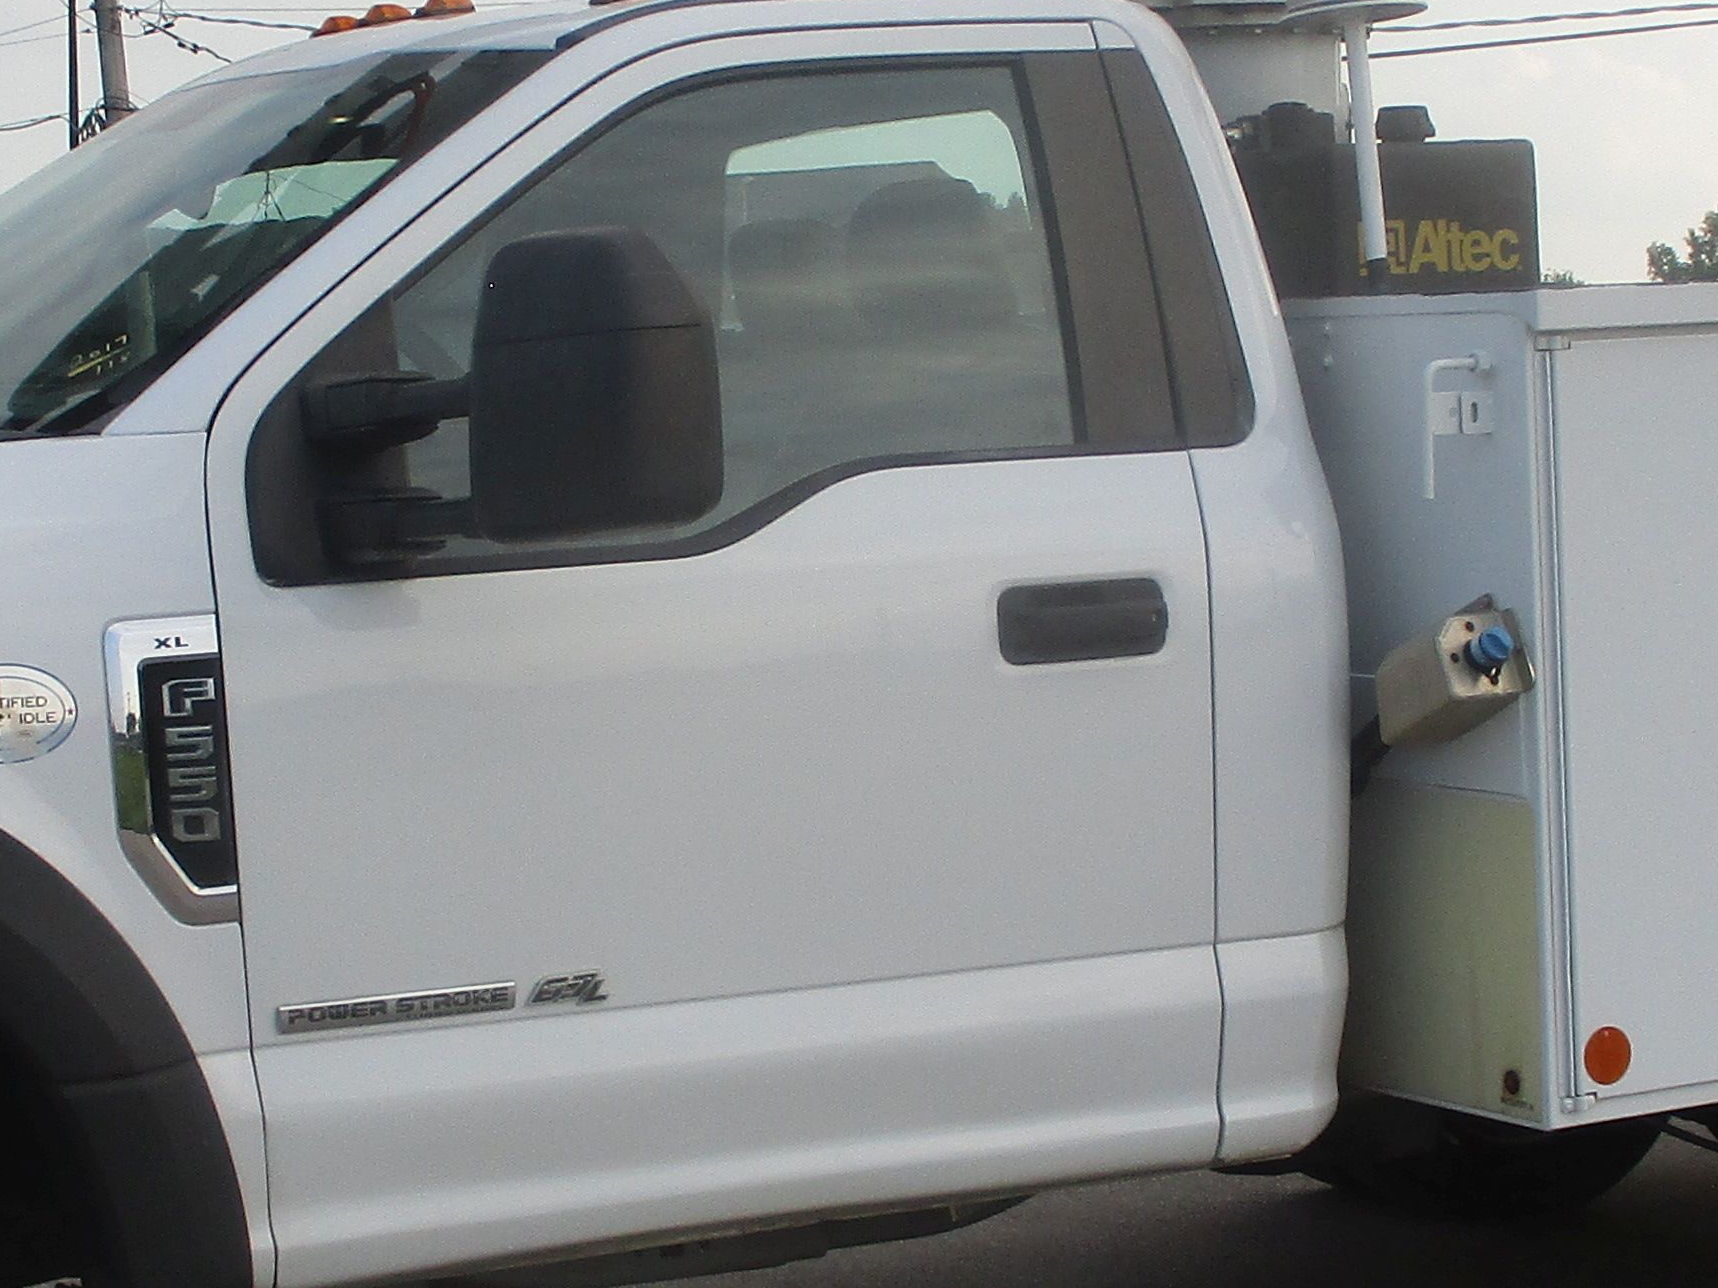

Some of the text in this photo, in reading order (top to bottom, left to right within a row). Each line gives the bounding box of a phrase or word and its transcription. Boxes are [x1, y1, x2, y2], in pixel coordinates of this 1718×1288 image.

[1409, 218, 1520, 274] Altec
[154, 636, 189, 650] XL
[18, 711, 57, 724] IDLE
[288, 999, 387, 1025] POWER
[395, 986, 509, 1014] STROKE
